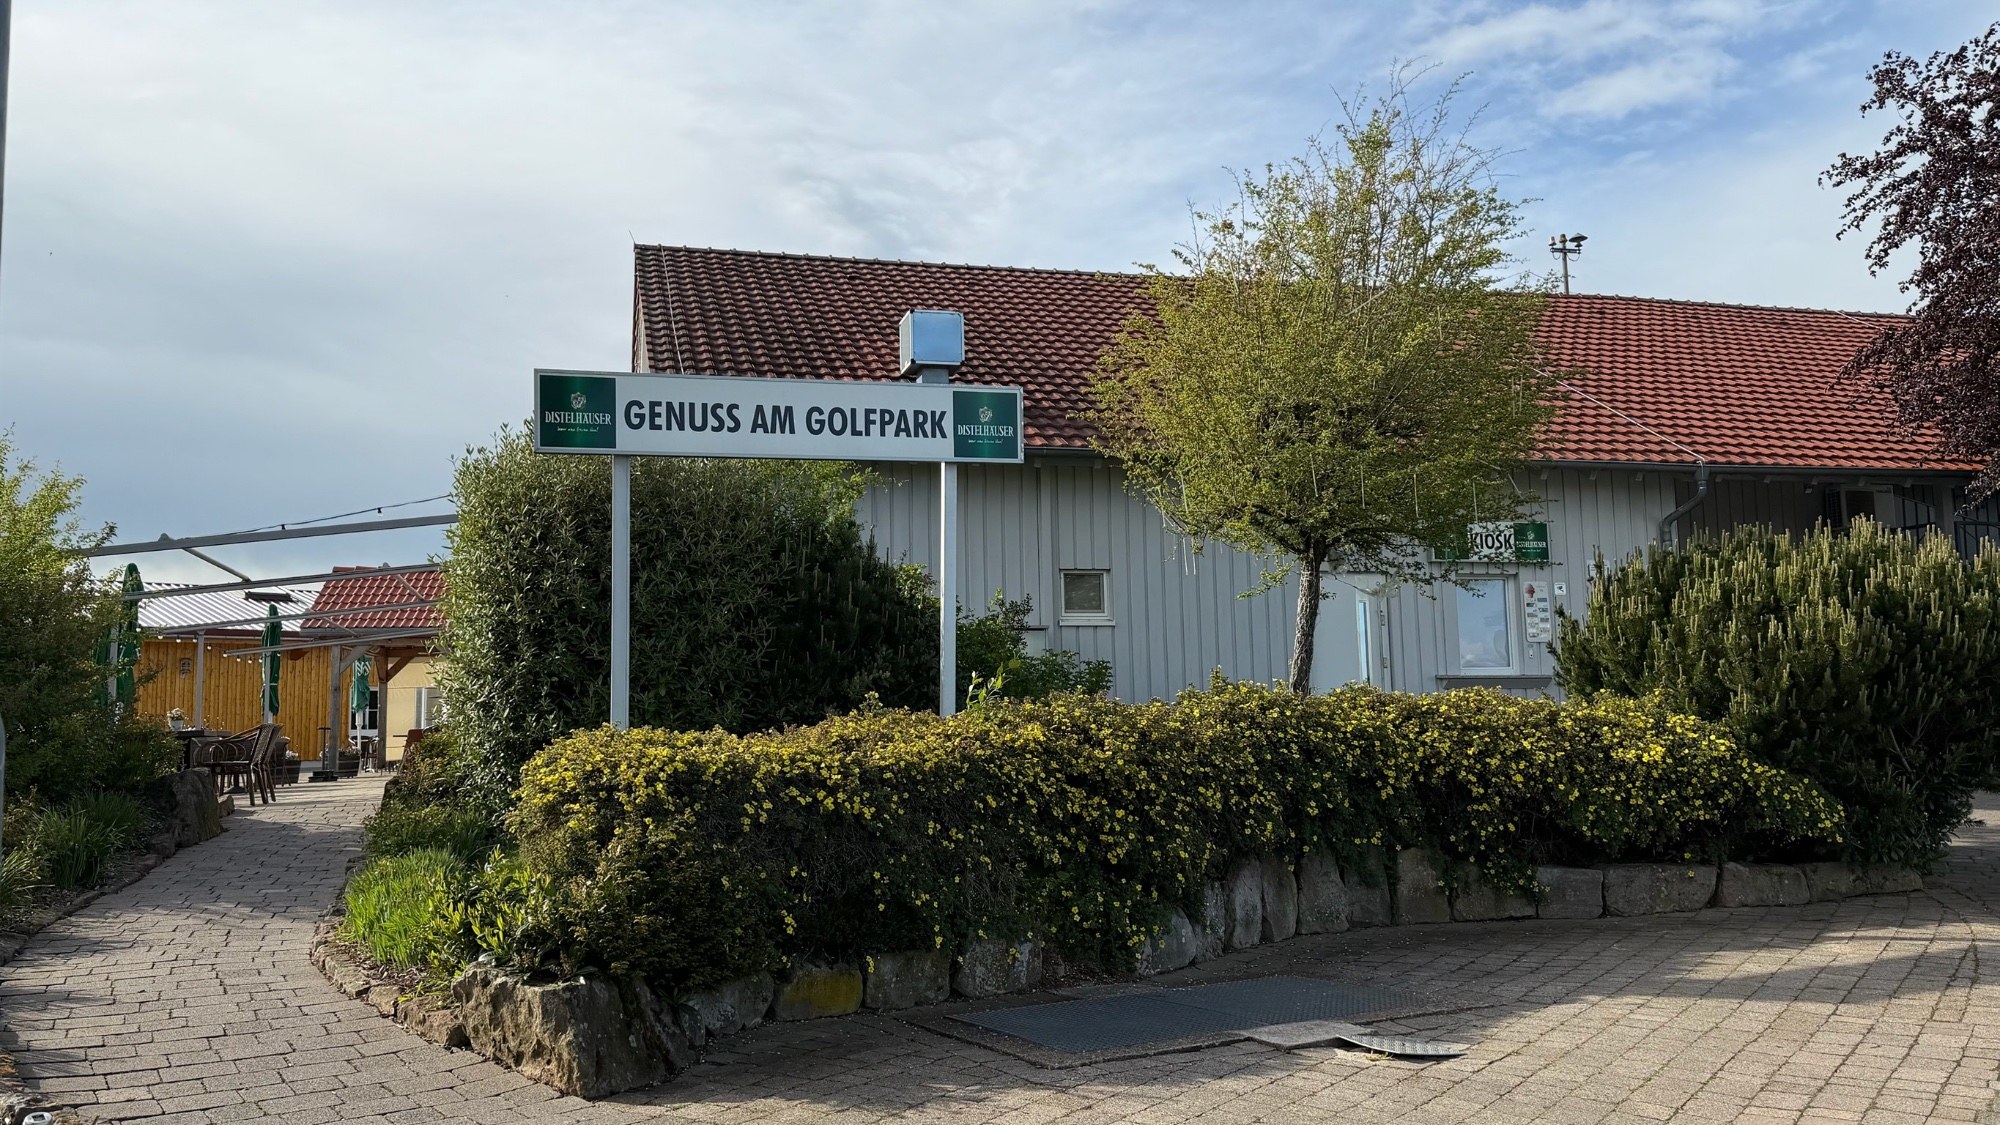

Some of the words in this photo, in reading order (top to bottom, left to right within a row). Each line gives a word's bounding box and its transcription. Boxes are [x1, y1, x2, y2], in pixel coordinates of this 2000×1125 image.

[545, 411, 611, 425] DISTELHÄUSER
[624, 399, 741, 433] GENUSS
[750, 404, 796, 435] AM
[805, 406, 948, 439] GOLFPARK
[957, 424, 1014, 437] DISTELHÄUSER
[1470, 533, 1513, 550] KIOSK
